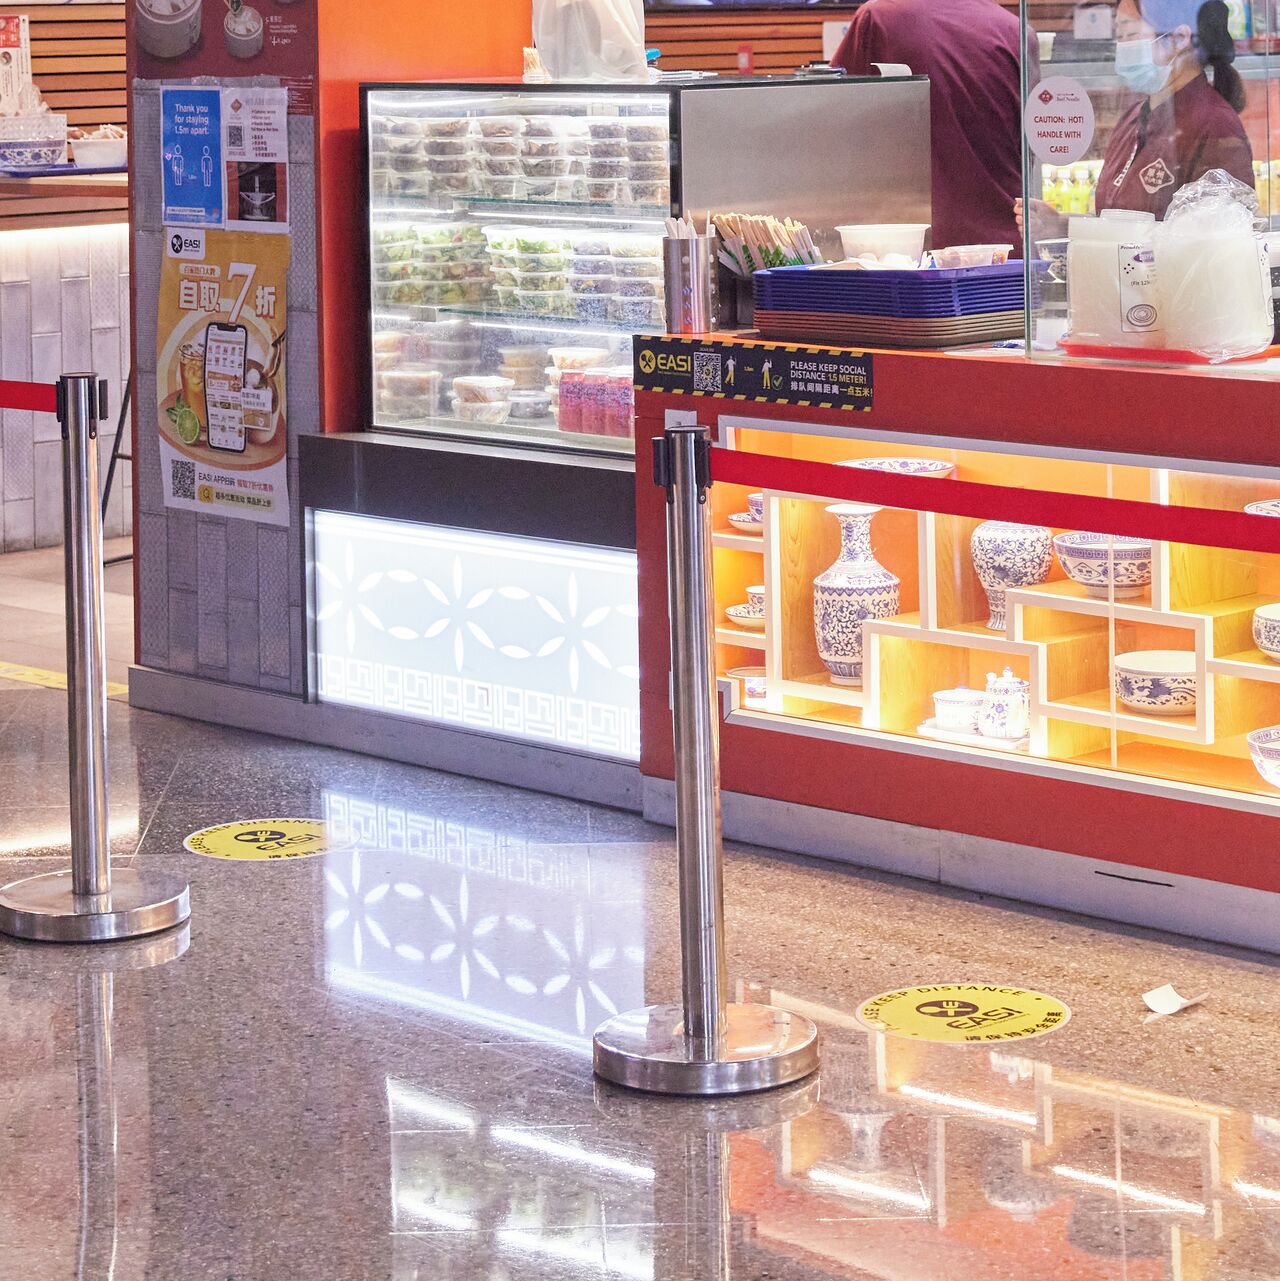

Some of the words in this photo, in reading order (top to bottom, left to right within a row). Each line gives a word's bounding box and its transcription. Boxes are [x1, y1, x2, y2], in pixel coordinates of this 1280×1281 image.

[175, 104, 195, 113] Thank
[196, 105, 208, 114] you
[175, 115, 184, 123] for
[185, 115, 209, 126] staying
[1068, 116, 1084, 124] HOT!
[175, 126, 189, 134] 1.5m
[1064, 131, 1081, 139] WITH
[184, 239, 200, 248] EASI
[657, 353, 691, 372] EASI
[790, 361, 817, 371] PLEASE
[819, 363, 838, 372] KEEP
[839, 365, 866, 375] SOCIAL
[790, 370, 826, 380] DISTANCE
[827, 373, 838, 381] 1.5
[839, 374, 867, 385] METER!
[256, 833, 320, 851] EASI
[872, 990, 908, 1007] KEEP
[917, 985, 1027, 997] DISTANCE
[945, 1007, 1022, 1029] EASI
